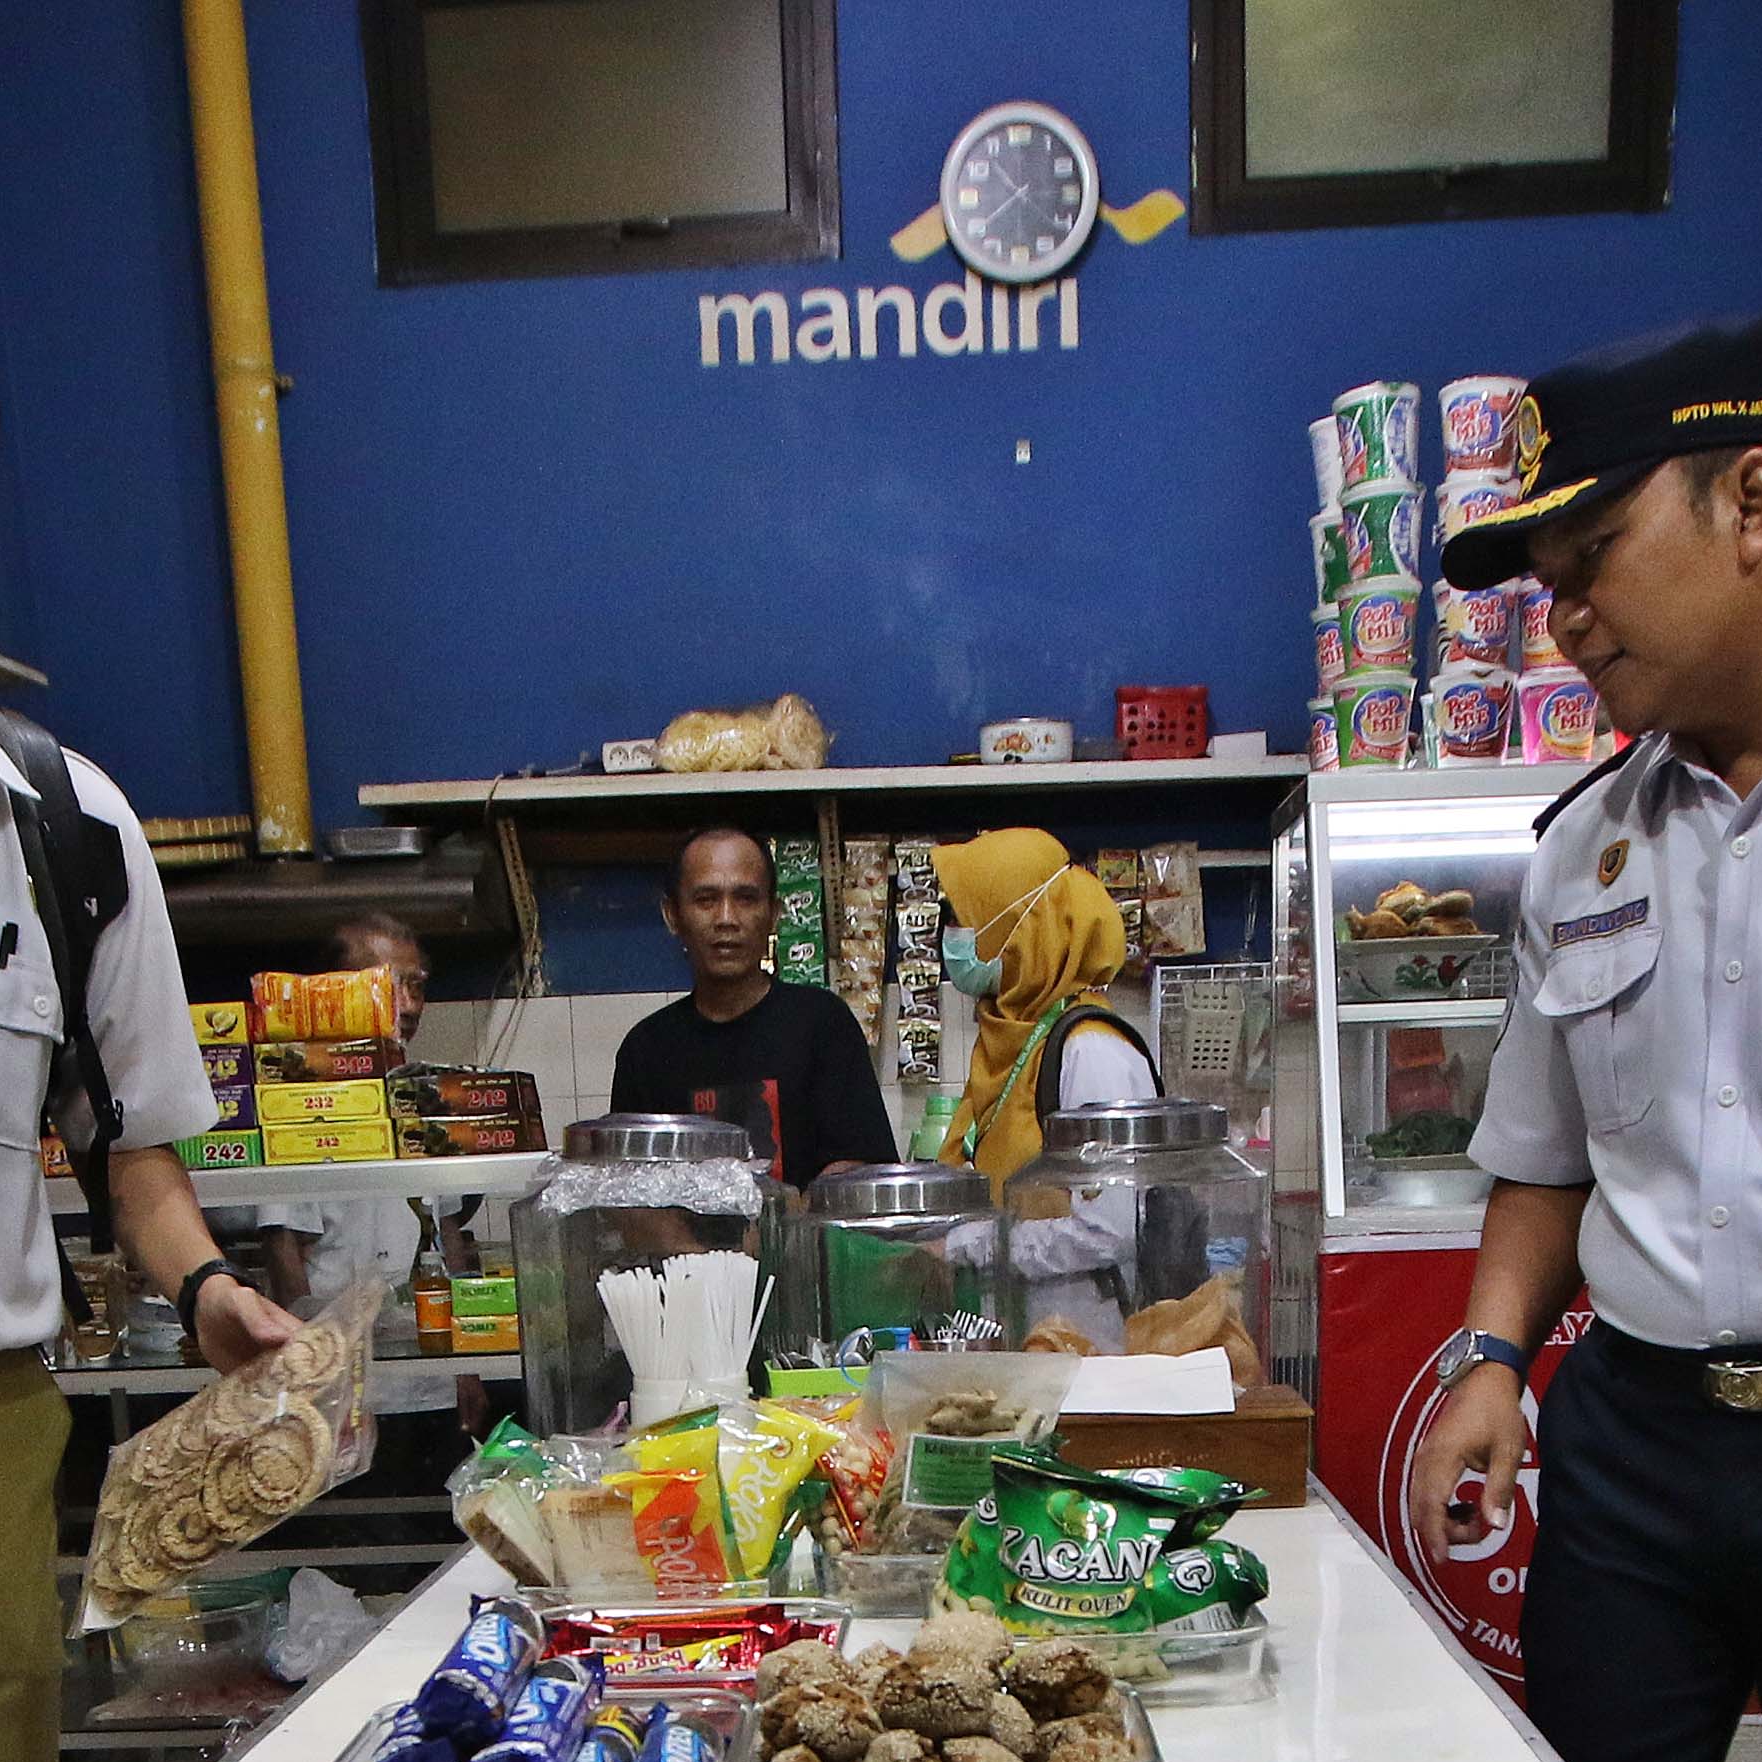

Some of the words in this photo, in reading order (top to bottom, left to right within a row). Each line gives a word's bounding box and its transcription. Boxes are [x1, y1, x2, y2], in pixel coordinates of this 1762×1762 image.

[698, 269, 1079, 367] mandiri
[1359, 601, 1395, 623] POP
[1466, 596, 1502, 620] POP
[1368, 617, 1406, 640] MIE
[1527, 620, 1549, 638] MI
[1366, 698, 1399, 719] POP
[1447, 693, 1481, 716] POP
[1554, 694, 1588, 717] POP
[1372, 715, 1404, 733] MIE
[1453, 708, 1488, 729] MIE
[1560, 710, 1593, 729] MIE
[204, 1145, 246, 1161] 242
[1022, 1587, 1070, 1611] KULIT
[1079, 1593, 1128, 1612] OVEN
